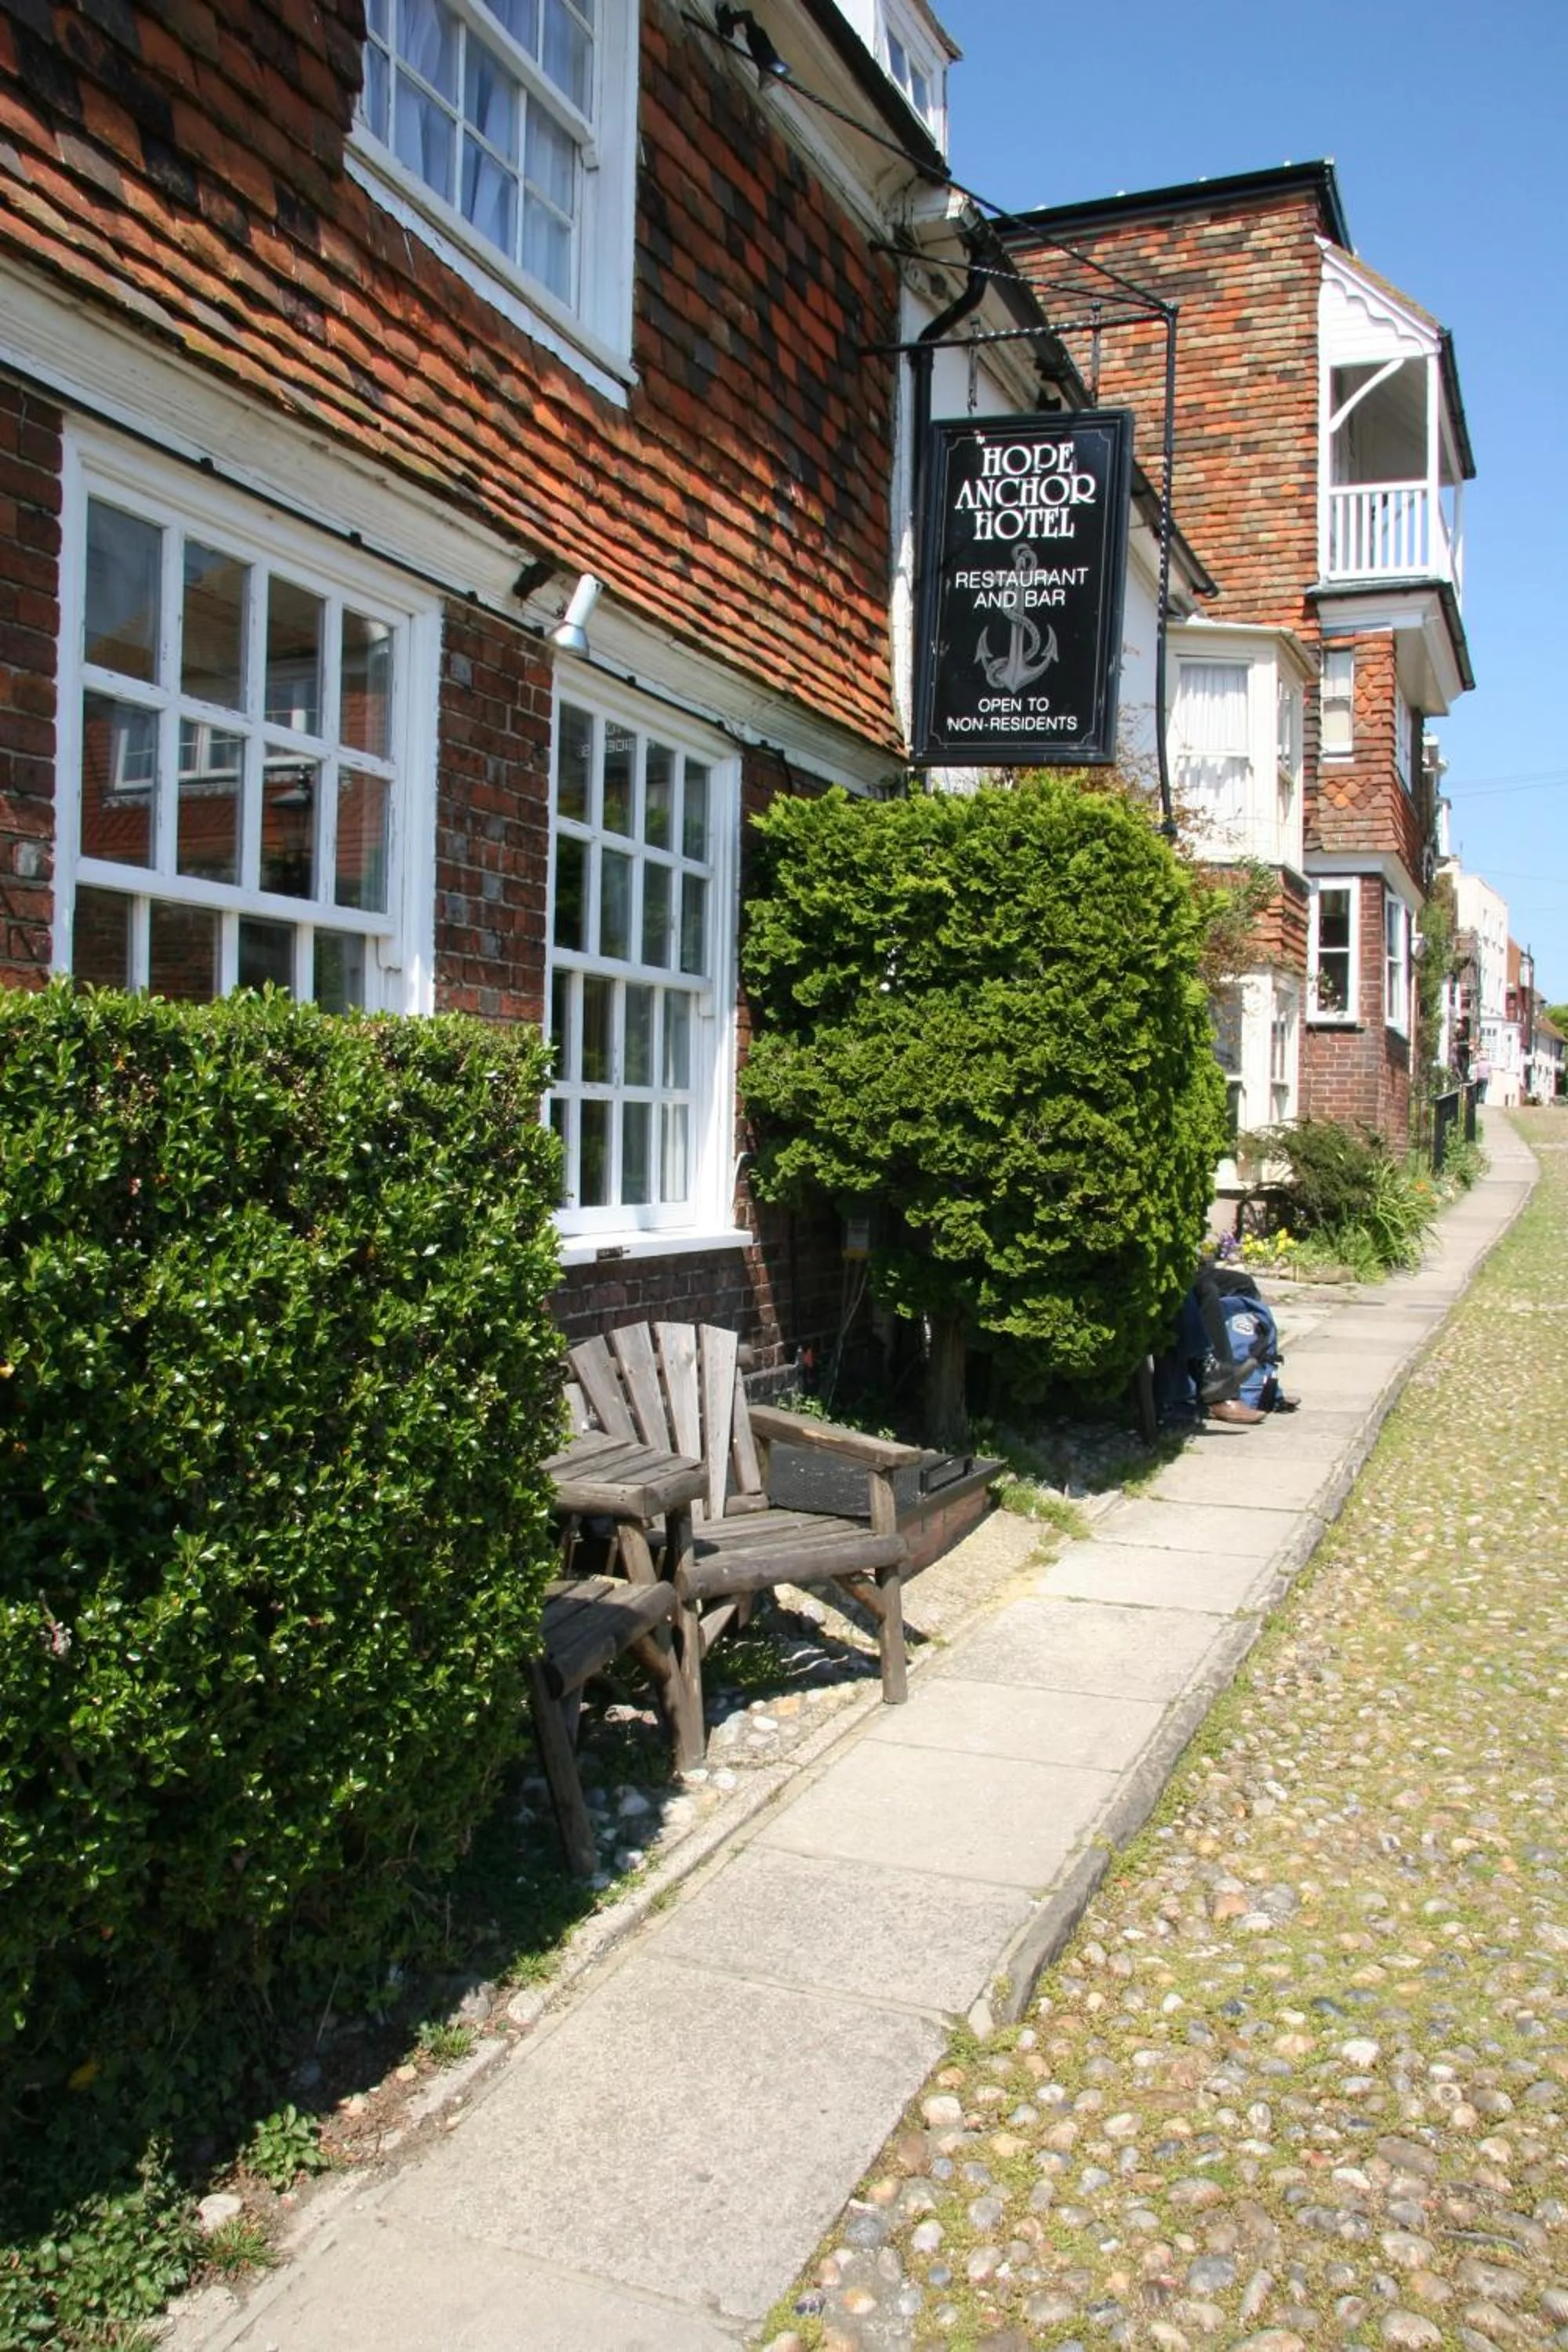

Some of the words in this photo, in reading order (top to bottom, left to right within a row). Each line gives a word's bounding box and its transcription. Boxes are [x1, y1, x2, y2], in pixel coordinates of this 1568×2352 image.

[982, 442, 1074, 477] HOPE
[955, 474, 1095, 510] ANCHOR
[973, 507, 1075, 540] HOTEL
[956, 568, 1088, 589] RESTAURANT
[974, 592, 1017, 609] AND
[1025, 590, 1066, 608] BAR
[978, 698, 1022, 713] OPEN
[1027, 697, 1050, 712] TO
[946, 716, 1078, 732] NON-RESIDENTS
